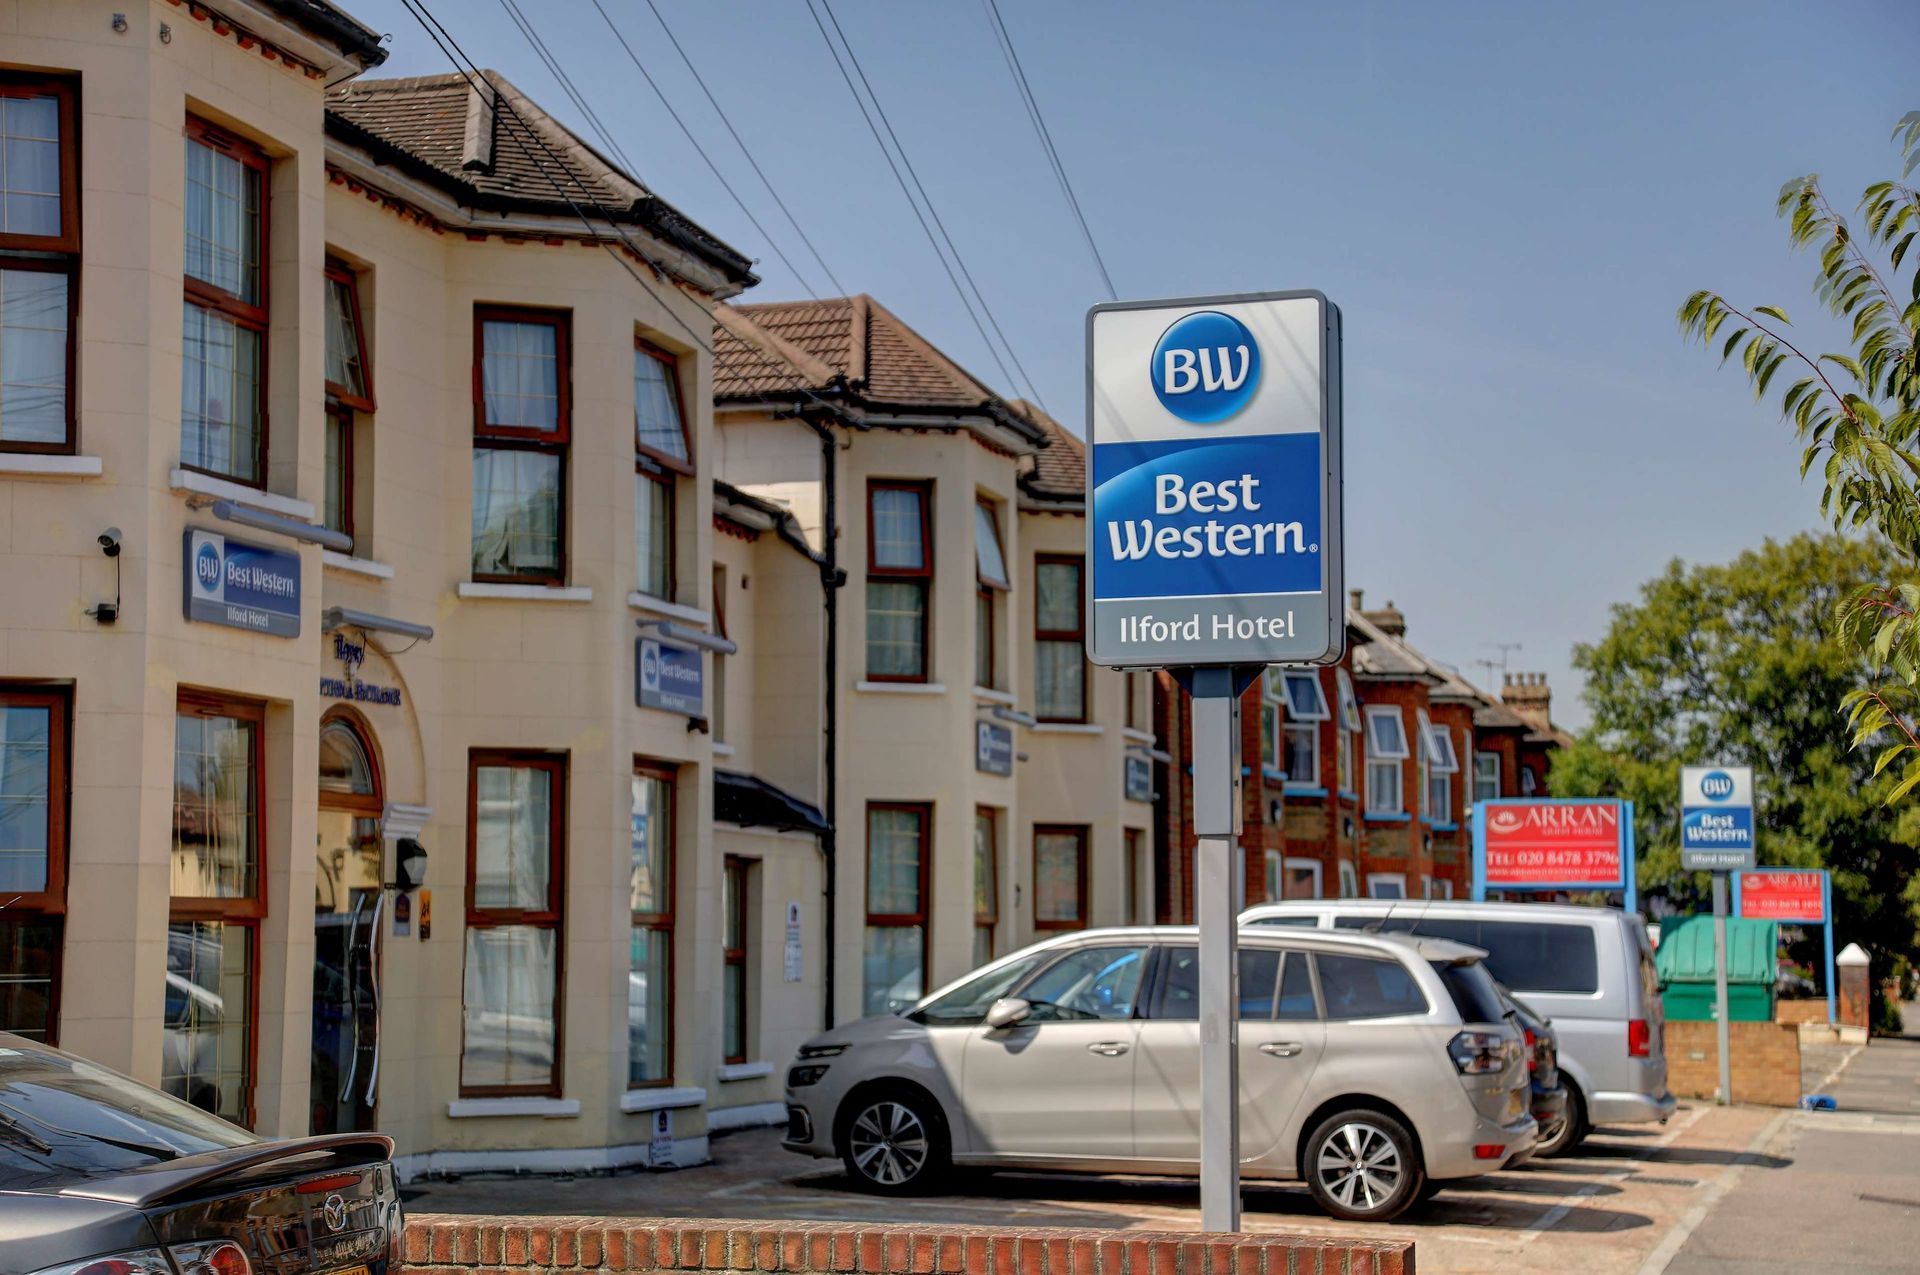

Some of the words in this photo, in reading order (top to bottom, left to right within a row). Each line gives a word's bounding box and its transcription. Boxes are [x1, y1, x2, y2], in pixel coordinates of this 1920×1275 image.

[1164, 345, 1249, 394] BW
[1156, 473, 1261, 514] Best
[200, 556, 218, 579] BW
[227, 561, 251, 584] Best
[227, 607, 247, 623] Ilford
[248, 611, 269, 628] Hotel
[1120, 614, 1200, 643] Ilford
[1212, 611, 1295, 640] Hotel
[1704, 779, 1731, 795] BW
[1524, 806, 1616, 827] ARRAN
[1702, 814, 1733, 827] Best
[1687, 826, 1748, 842] Western
[1517, 851, 1544, 866] 020
